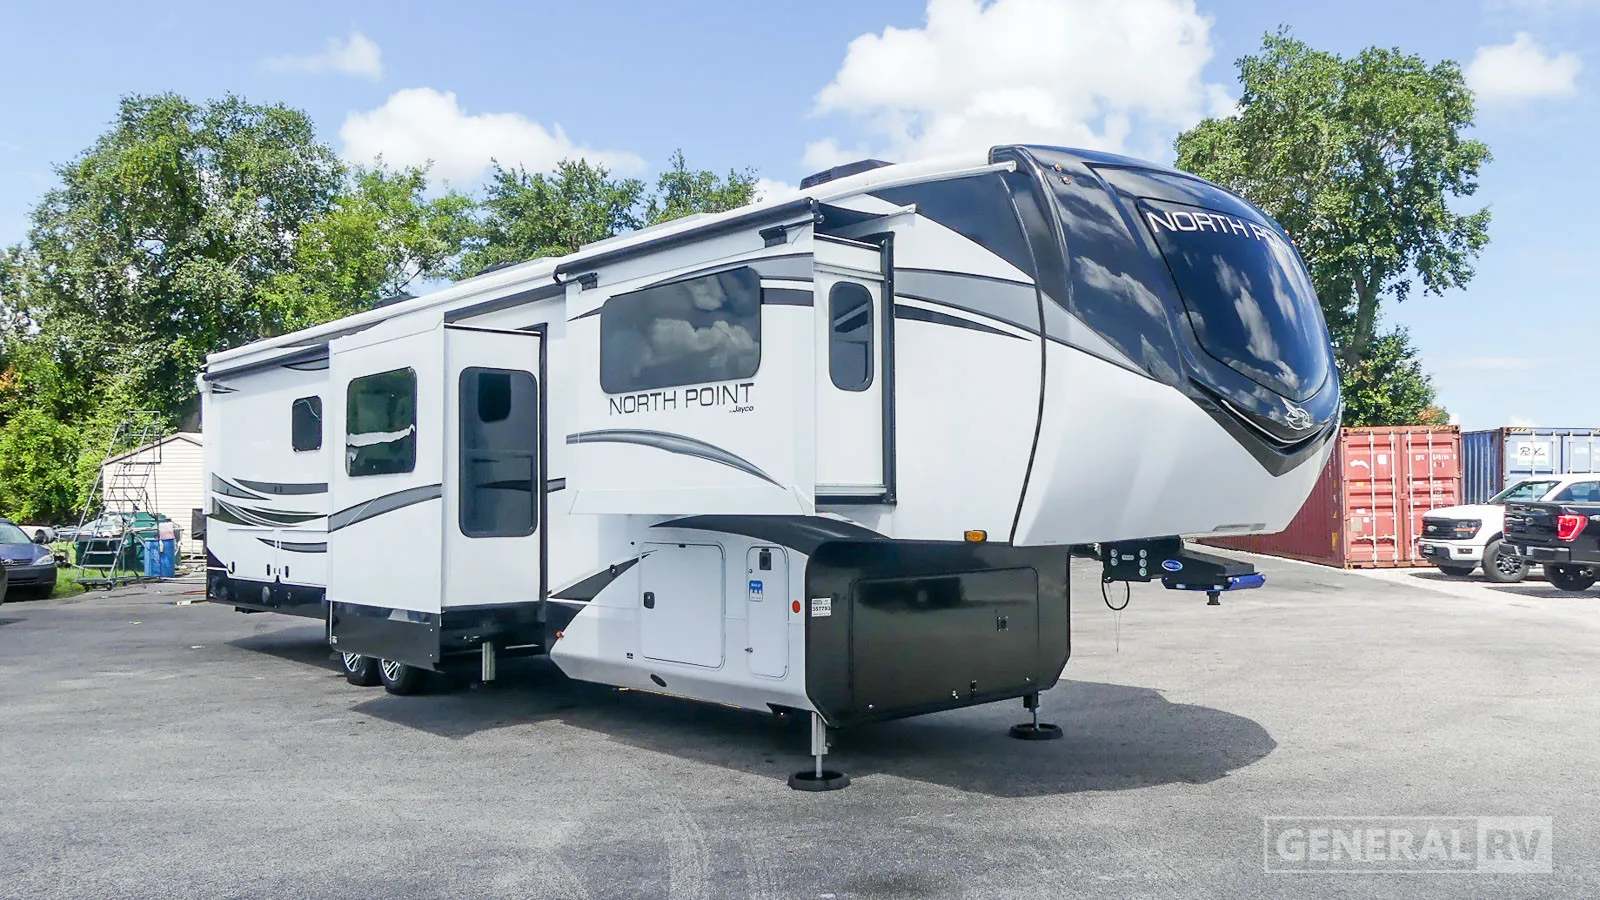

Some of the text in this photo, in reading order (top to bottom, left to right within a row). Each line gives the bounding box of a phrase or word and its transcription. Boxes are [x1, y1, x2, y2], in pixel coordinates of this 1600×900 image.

[1146, 211, 1249, 237] NORTH
[610, 383, 754, 415] NORTH POINT
[733, 405, 754, 413] Jayco
